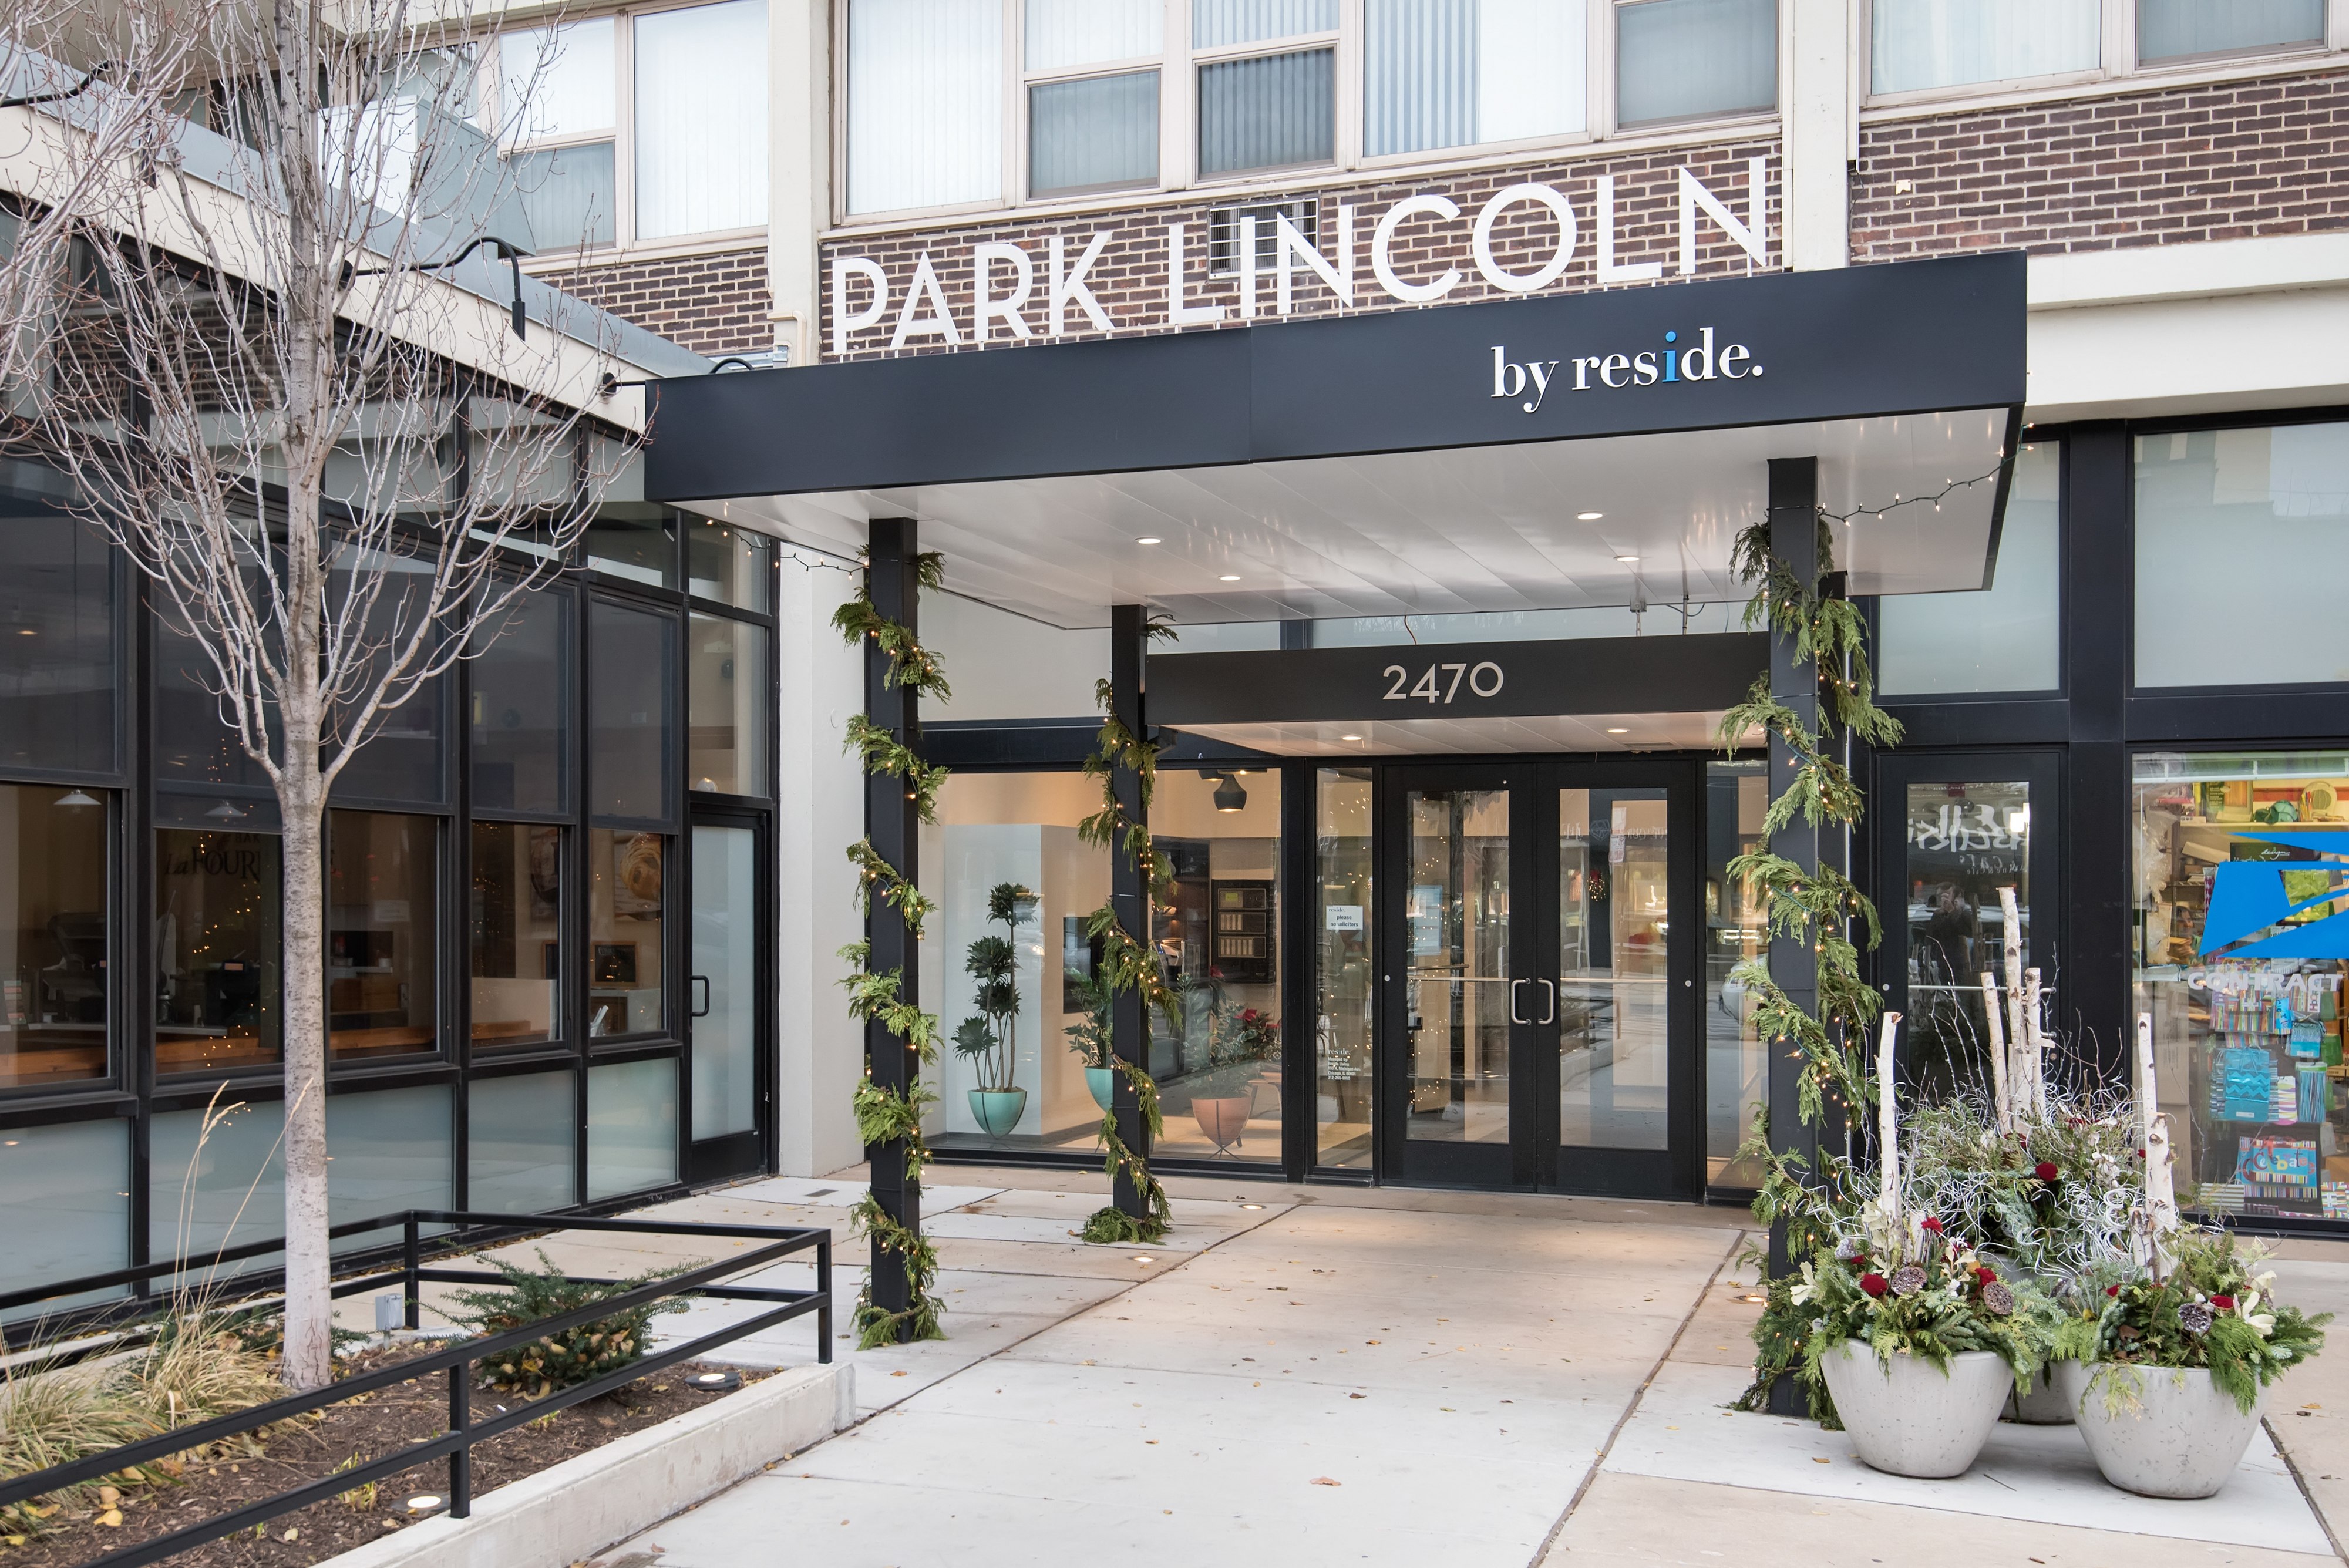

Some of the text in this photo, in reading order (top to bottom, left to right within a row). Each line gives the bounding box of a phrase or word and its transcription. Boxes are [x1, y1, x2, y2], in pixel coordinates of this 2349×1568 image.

[831, 157, 1766, 355] PARK LINCOLN
[1490, 327, 1764, 415] by reside.
[1382, 661, 1504, 704] 2470
[191, 846, 261, 883] FOUR
[2188, 972, 2345, 992] CONTRACT
